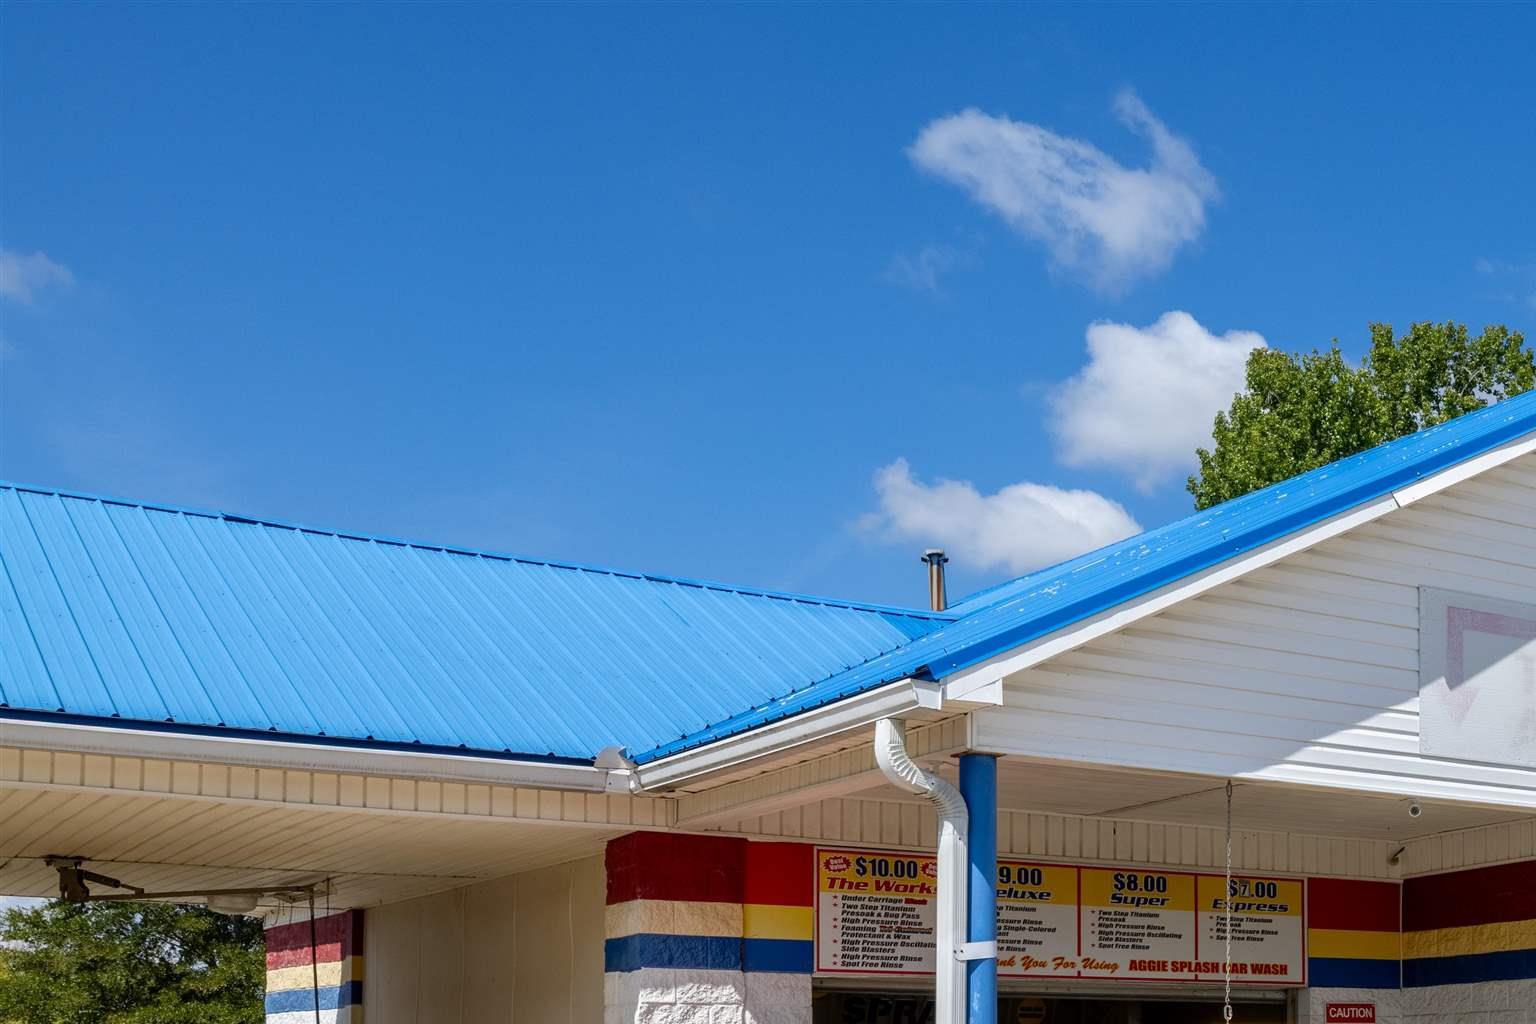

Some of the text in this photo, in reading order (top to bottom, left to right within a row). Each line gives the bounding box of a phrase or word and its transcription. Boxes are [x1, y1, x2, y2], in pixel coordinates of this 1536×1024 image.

[856, 856, 917, 878] $10.00
[999, 866, 1042, 885] 9.00
[1113, 873, 1166, 892] $8.00
[827, 877, 937, 894] The Work
[1229, 880, 1276, 898] $7.00
[868, 896, 903, 904] Carriage
[997, 888, 1051, 900] eluxe
[1110, 893, 1169, 907] Super
[1212, 899, 1288, 912] Express
[883, 911, 899, 919] Bug
[1020, 955, 1047, 971] You
[1052, 957, 1078, 970] For
[1081, 957, 1119, 974] Using
[1129, 960, 1288, 975] AGGIE SPLASH CAR WASH
[1329, 1007, 1373, 1018] CAUTION
